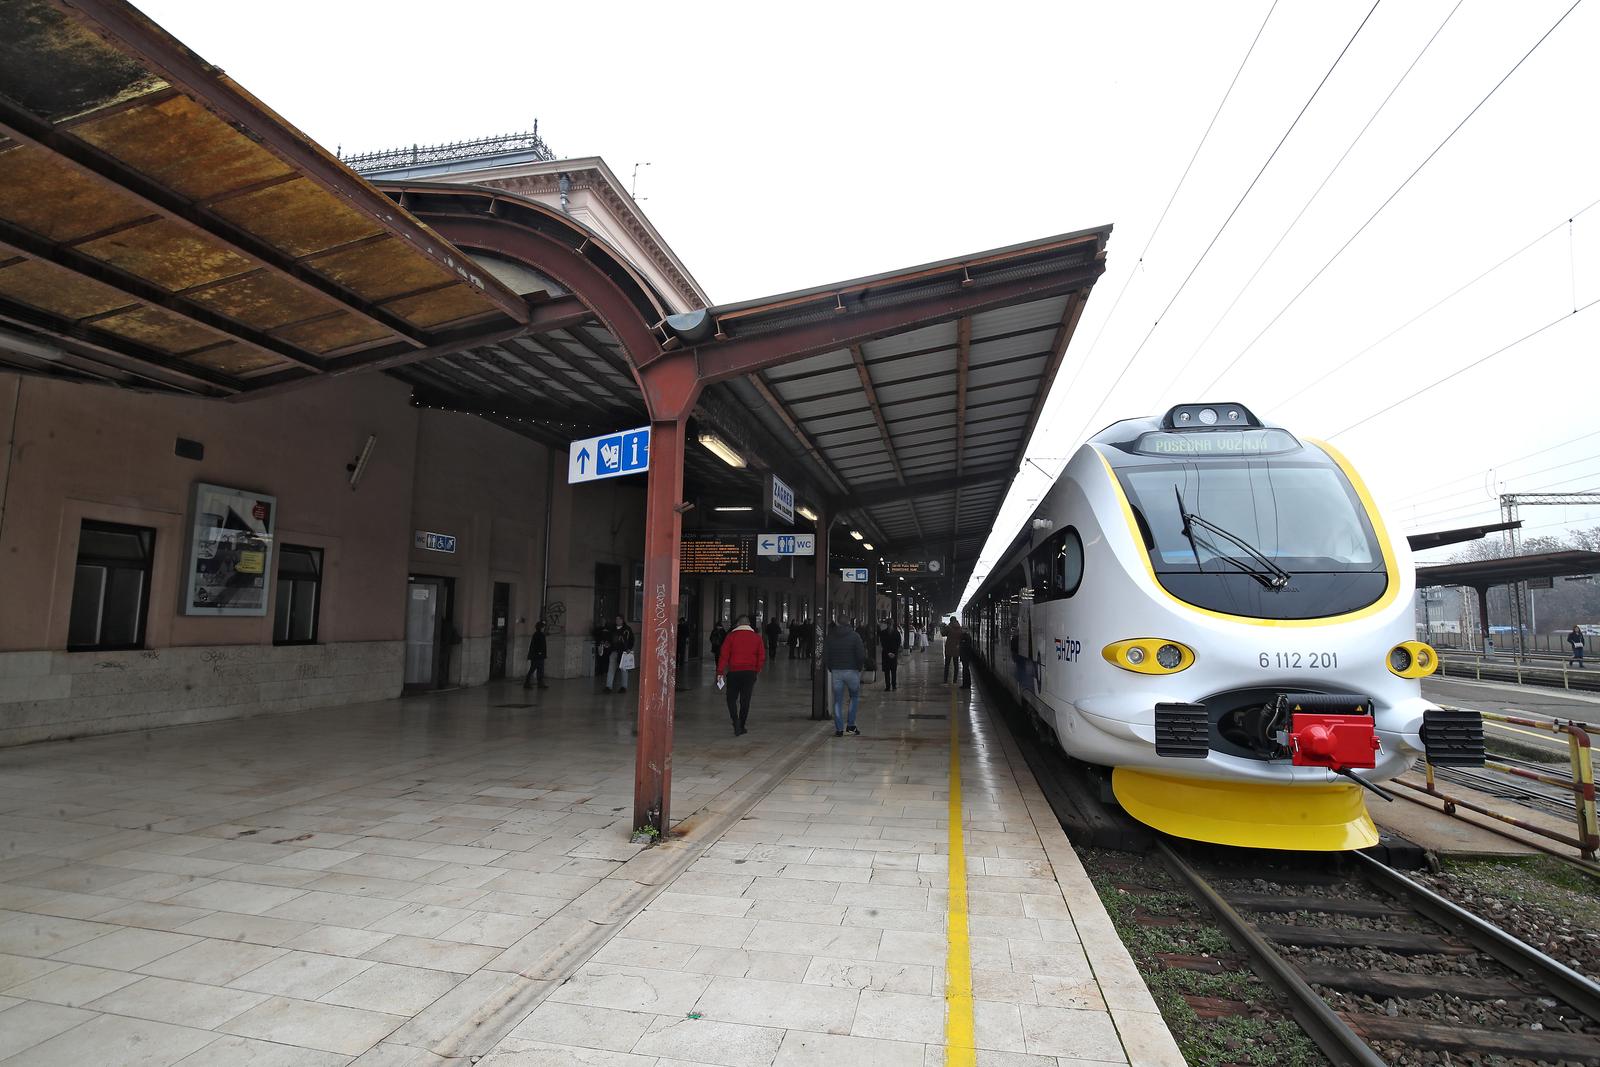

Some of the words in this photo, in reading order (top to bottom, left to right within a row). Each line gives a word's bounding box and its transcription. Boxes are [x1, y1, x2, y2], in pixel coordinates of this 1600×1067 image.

[774, 482, 792, 508] ZAGREB
[796, 541, 811, 549] WC
[1258, 652, 1270, 668] 6
[1275, 652, 1302, 668] 112
[1308, 652, 1338, 668] 201
